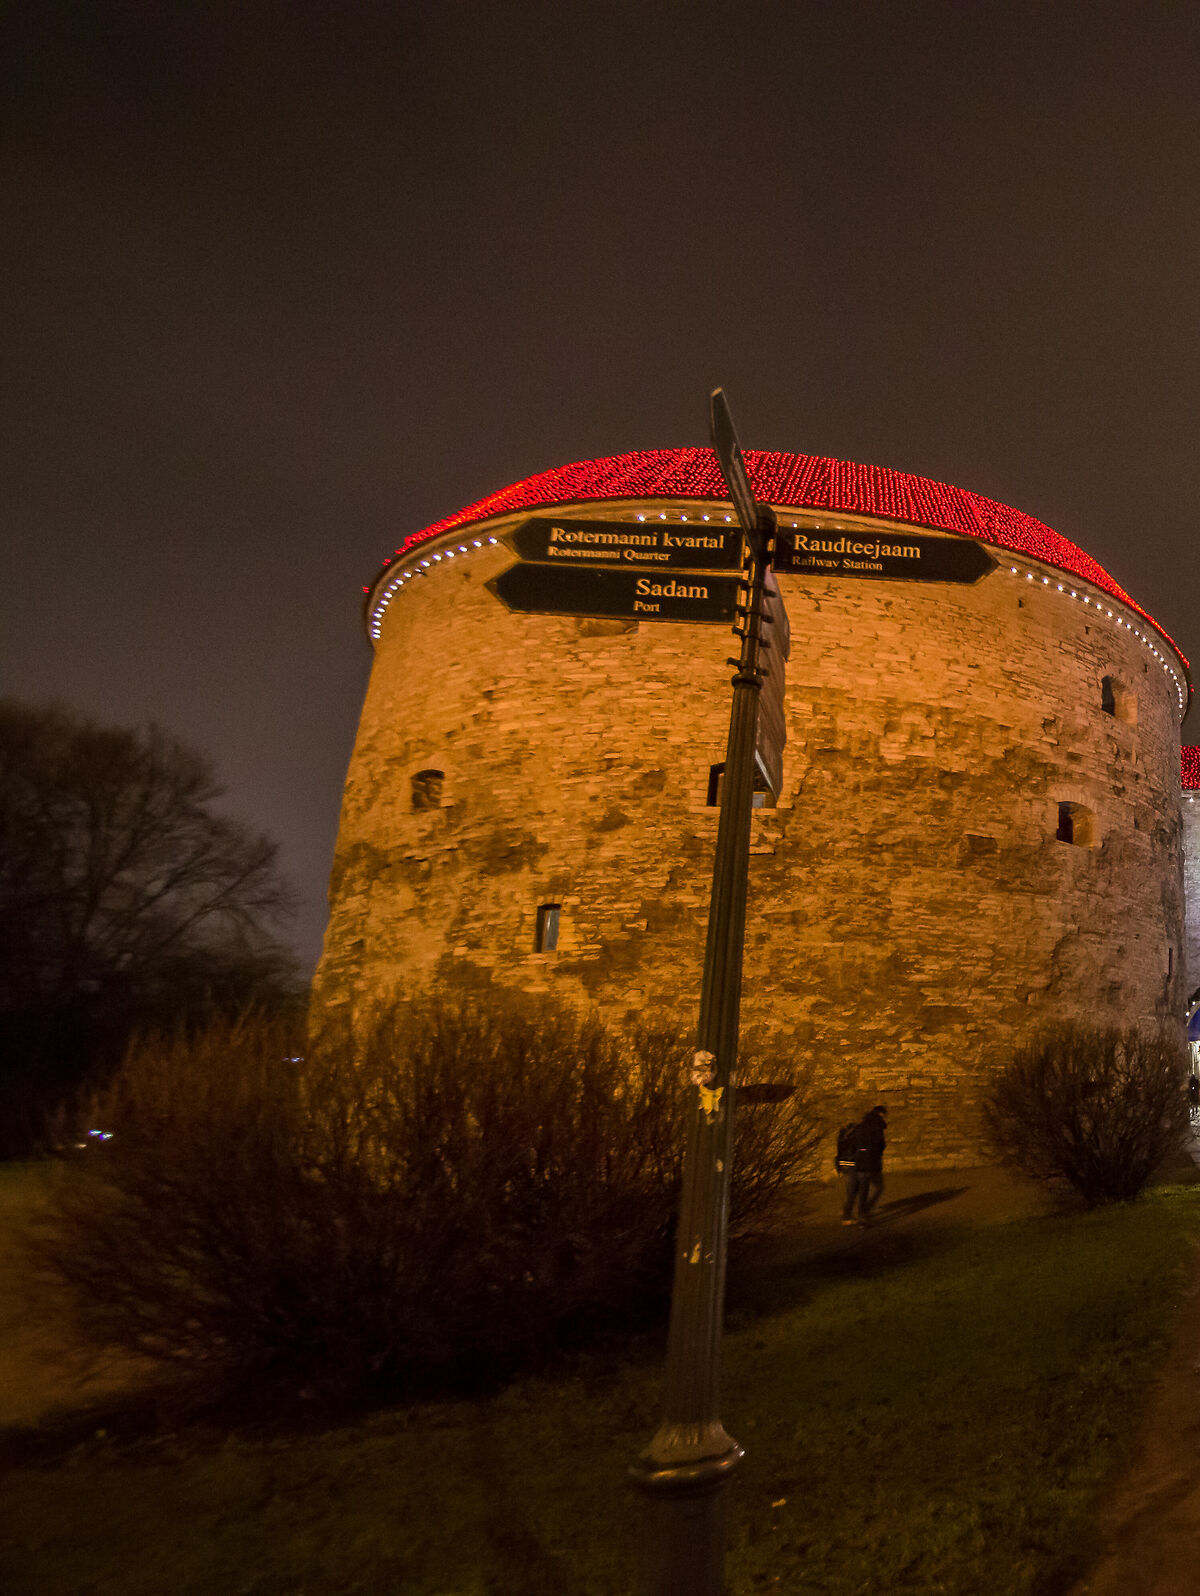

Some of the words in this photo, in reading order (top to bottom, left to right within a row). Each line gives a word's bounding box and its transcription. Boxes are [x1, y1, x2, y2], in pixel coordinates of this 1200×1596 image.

[551, 527, 657, 546] Rotermanni
[663, 532, 724, 549] kvartal
[794, 534, 920, 559] Raudteejaam
[548, 546, 620, 559] Rotermanni
[623, 549, 671, 561] Quarter
[792, 555, 840, 569] Railway
[843, 558, 883, 571] Station
[635, 578, 709, 599] Sadam
[633, 600, 660, 613] Port
